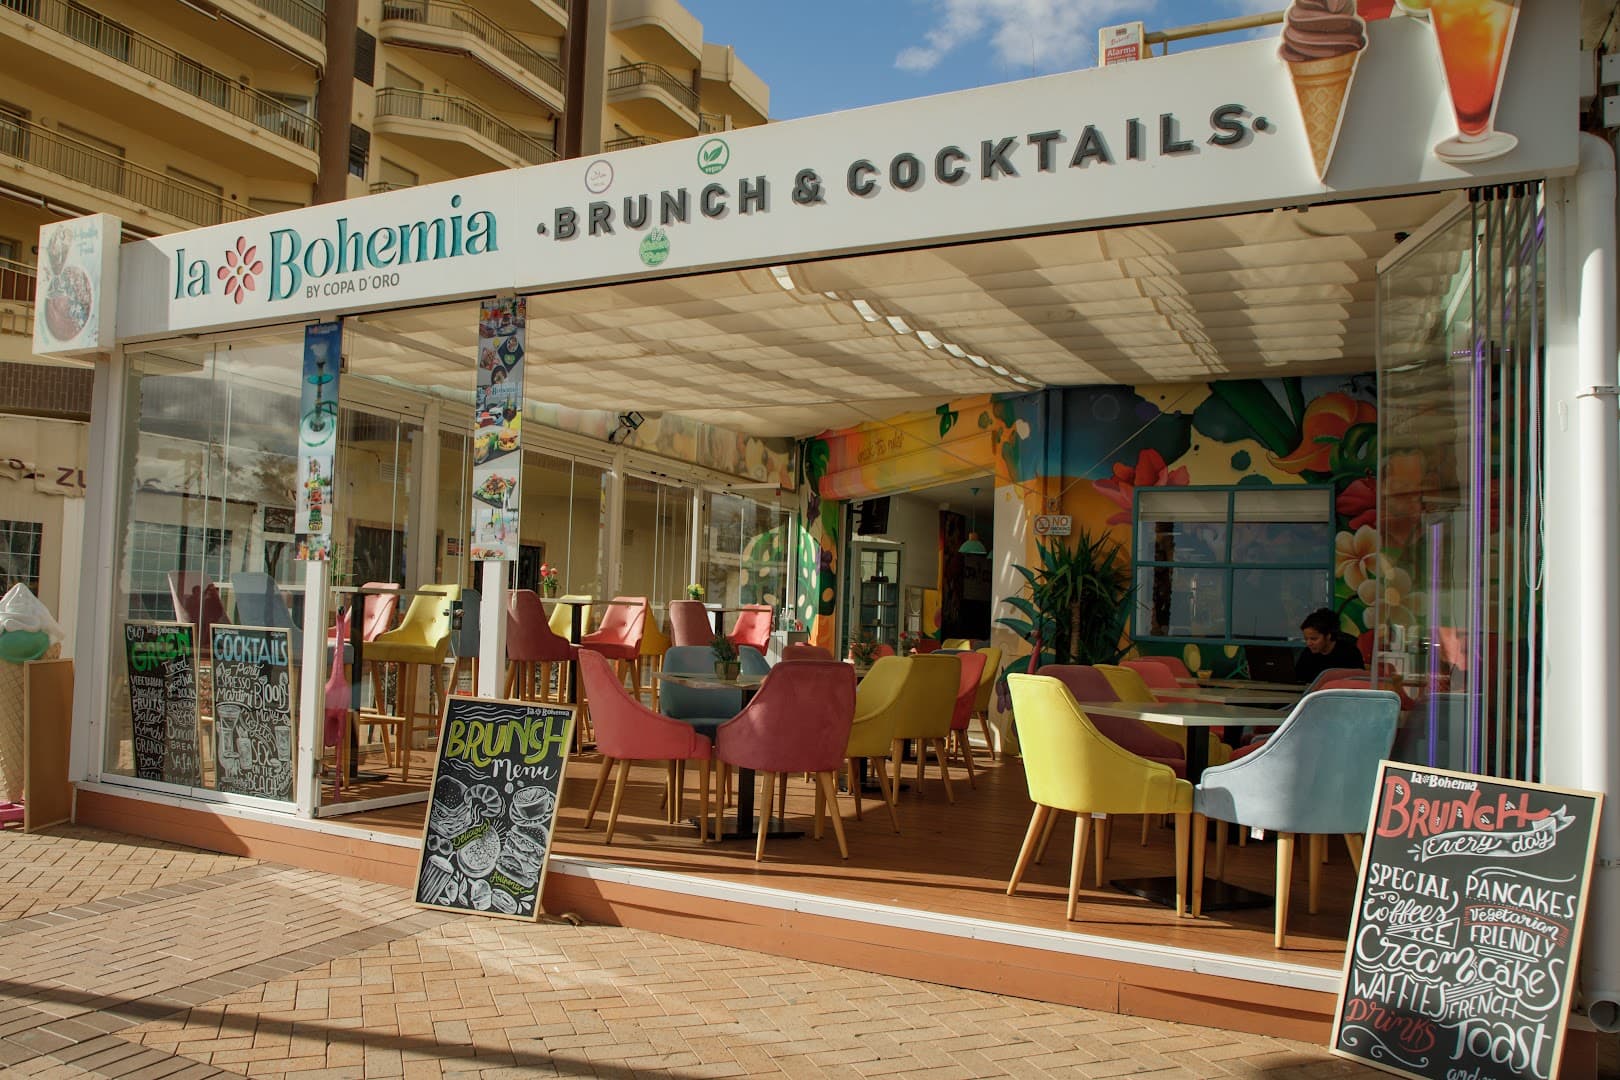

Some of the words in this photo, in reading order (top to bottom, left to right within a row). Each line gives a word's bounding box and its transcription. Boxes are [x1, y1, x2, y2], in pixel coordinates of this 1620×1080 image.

[1107, 46, 1136, 57] Alarma
[553, 175, 767, 241] BRUNCH
[791, 168, 824, 204] &
[174, 248, 212, 301] la
[268, 194, 500, 303] Bohemia
[306, 285, 321, 299] BY
[323, 278, 355, 296] COPA
[1053, 516, 1068, 527] NO
[131, 630, 192, 672] GREEN
[214, 633, 289, 666] COCKTAILS
[231, 662, 265, 681] Party
[252, 739, 272, 767] SEX
[446, 716, 571, 768] BRUNCH
[492, 758, 558, 782] Menu
[1428, 774, 1478, 792] Bohemia
[1511, 828, 1554, 854] day
[1369, 863, 1450, 900] SPECIAL
[1465, 874, 1577, 919] PANCAKES
[1411, 922, 1454, 946] ICE
[1470, 925, 1556, 959] FRIENDLY
[1357, 924, 1475, 984] Cream
[1354, 968, 1451, 1019] WAFFLES
[1448, 990, 1521, 1020] FRENCH
